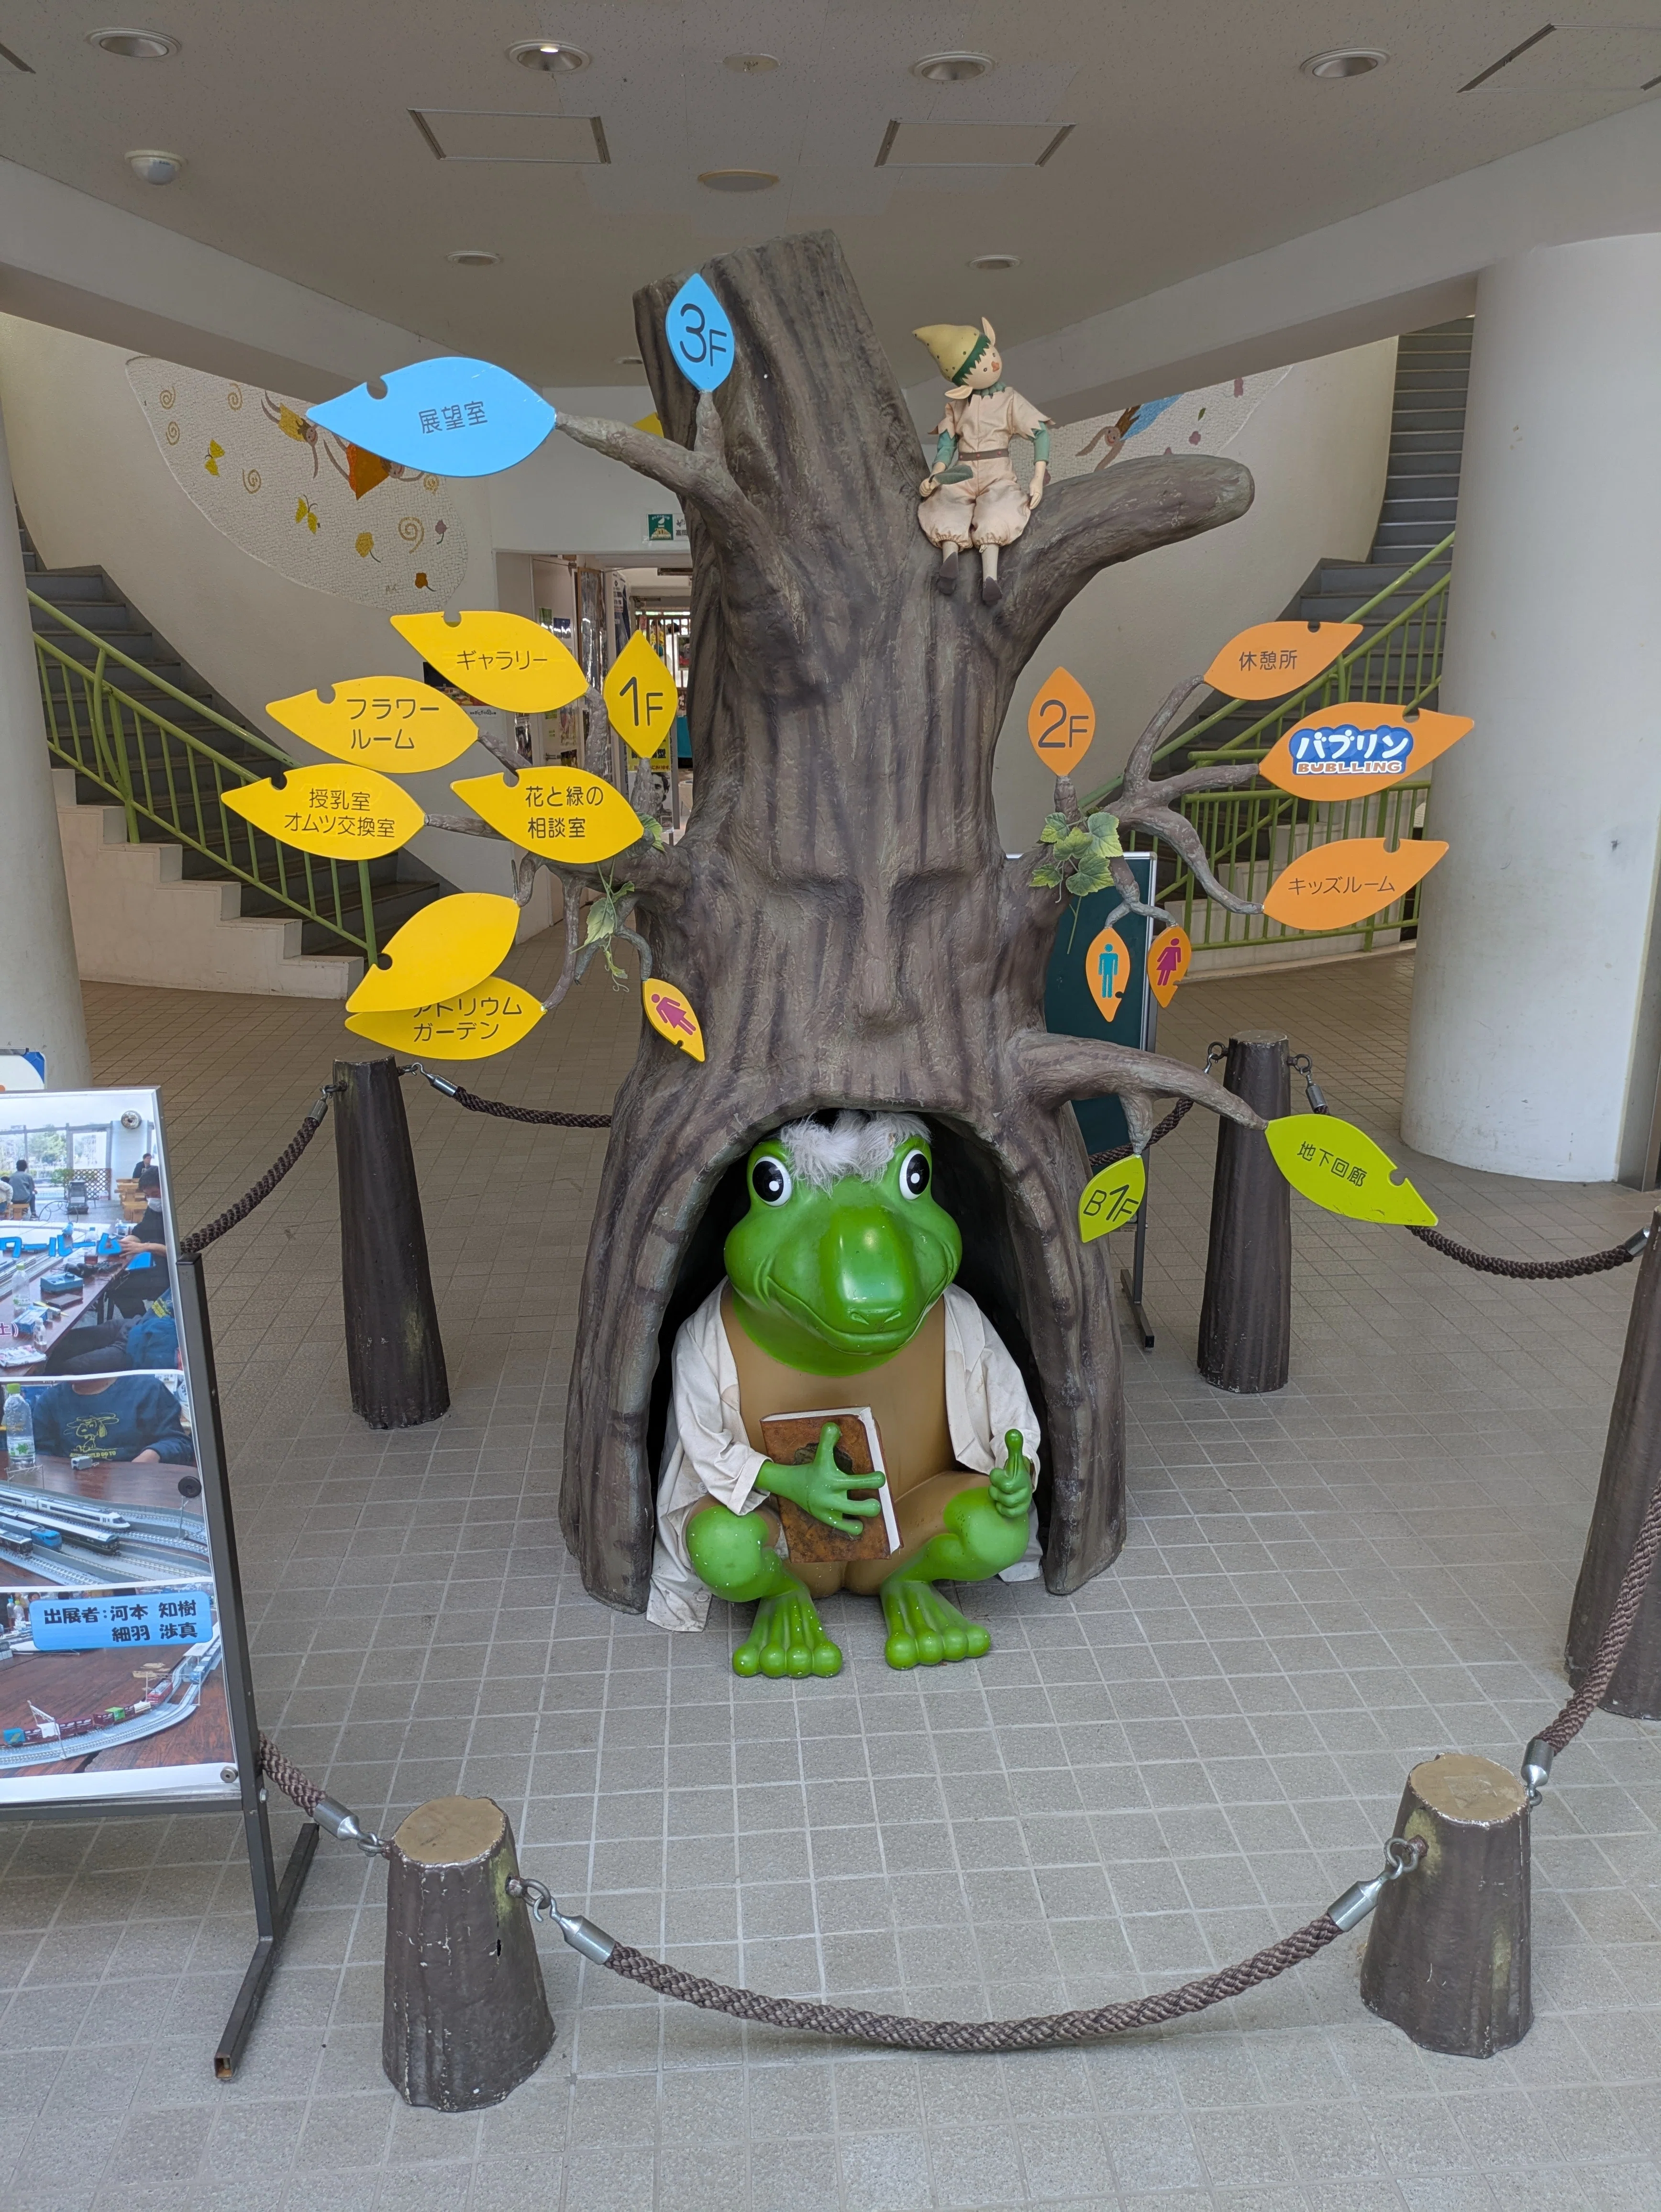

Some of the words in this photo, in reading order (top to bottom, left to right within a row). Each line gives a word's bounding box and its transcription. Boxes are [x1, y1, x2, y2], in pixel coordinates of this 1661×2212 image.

[679, 302, 727, 367] 3F
[419, 400, 488, 434] 展望室
[456, 650, 548, 671] ギャラリー
[1239, 650, 1298, 672] 休憩所
[346, 699, 440, 720] フラワー
[619, 676, 664, 727] 1F
[1037, 699, 1089, 749] 2F
[351, 729, 415, 750] ルーム
[1296, 760, 1402, 774] BUBLLING
[309, 788, 370, 811] 授乳室
[525, 785, 603, 807] 花と緑の
[284, 812, 395, 838] オムツ交換室
[527, 817, 586, 839] 相談室
[1288, 875, 1395, 896] キッズルーム
[413, 1022, 499, 1042] ガーデン
[1296, 1140, 1367, 1187] 地下回廊
[1083, 1184, 1140, 1223] B1F
[158, 1599, 197, 1618] 知樹
[111, 1625, 150, 1643] 細羽
[159, 1622, 198, 1639] 渉真
